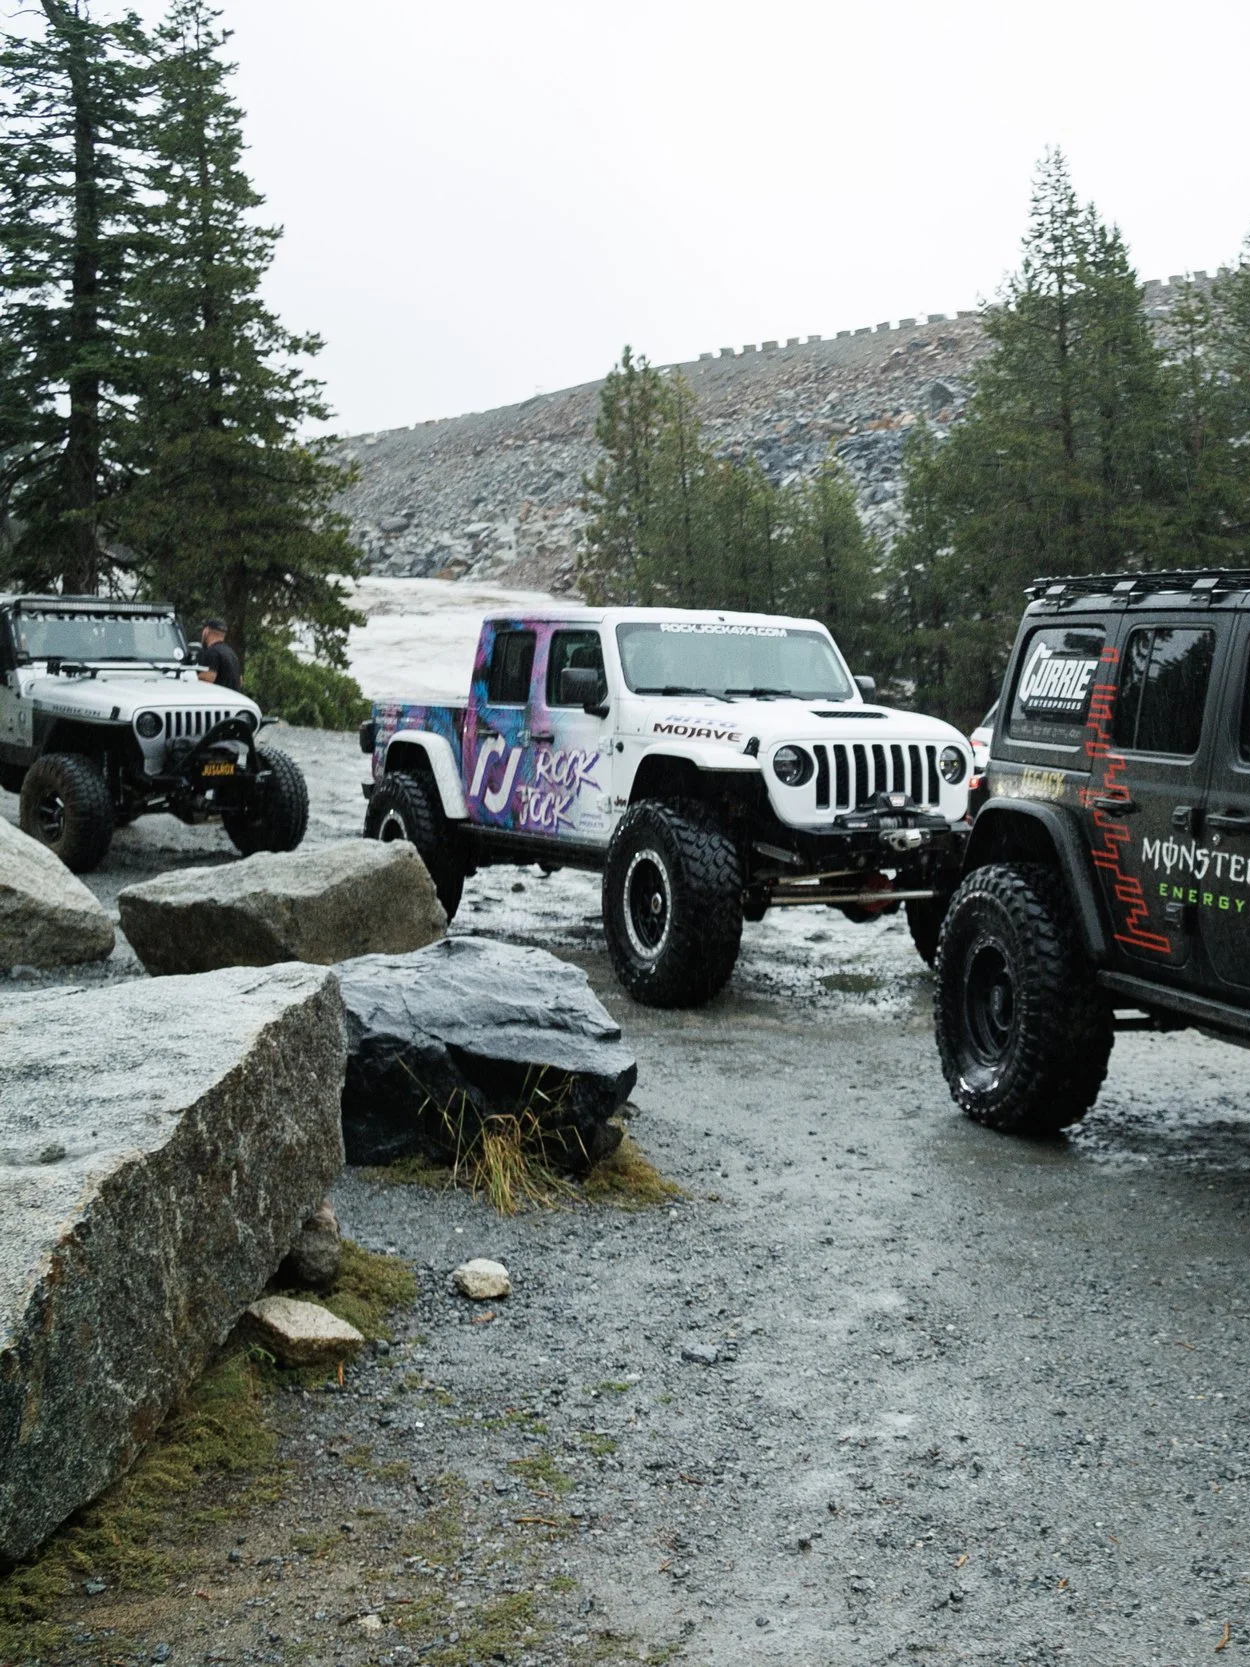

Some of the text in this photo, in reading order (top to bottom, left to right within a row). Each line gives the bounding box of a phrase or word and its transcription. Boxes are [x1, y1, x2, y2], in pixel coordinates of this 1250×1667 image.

[1019, 642, 1098, 702] CURRIE
[1027, 699, 1082, 710] ENTERPRISES
[653, 723, 742, 742] MOJAVE
[1159, 883, 1245, 913] ENERGY
